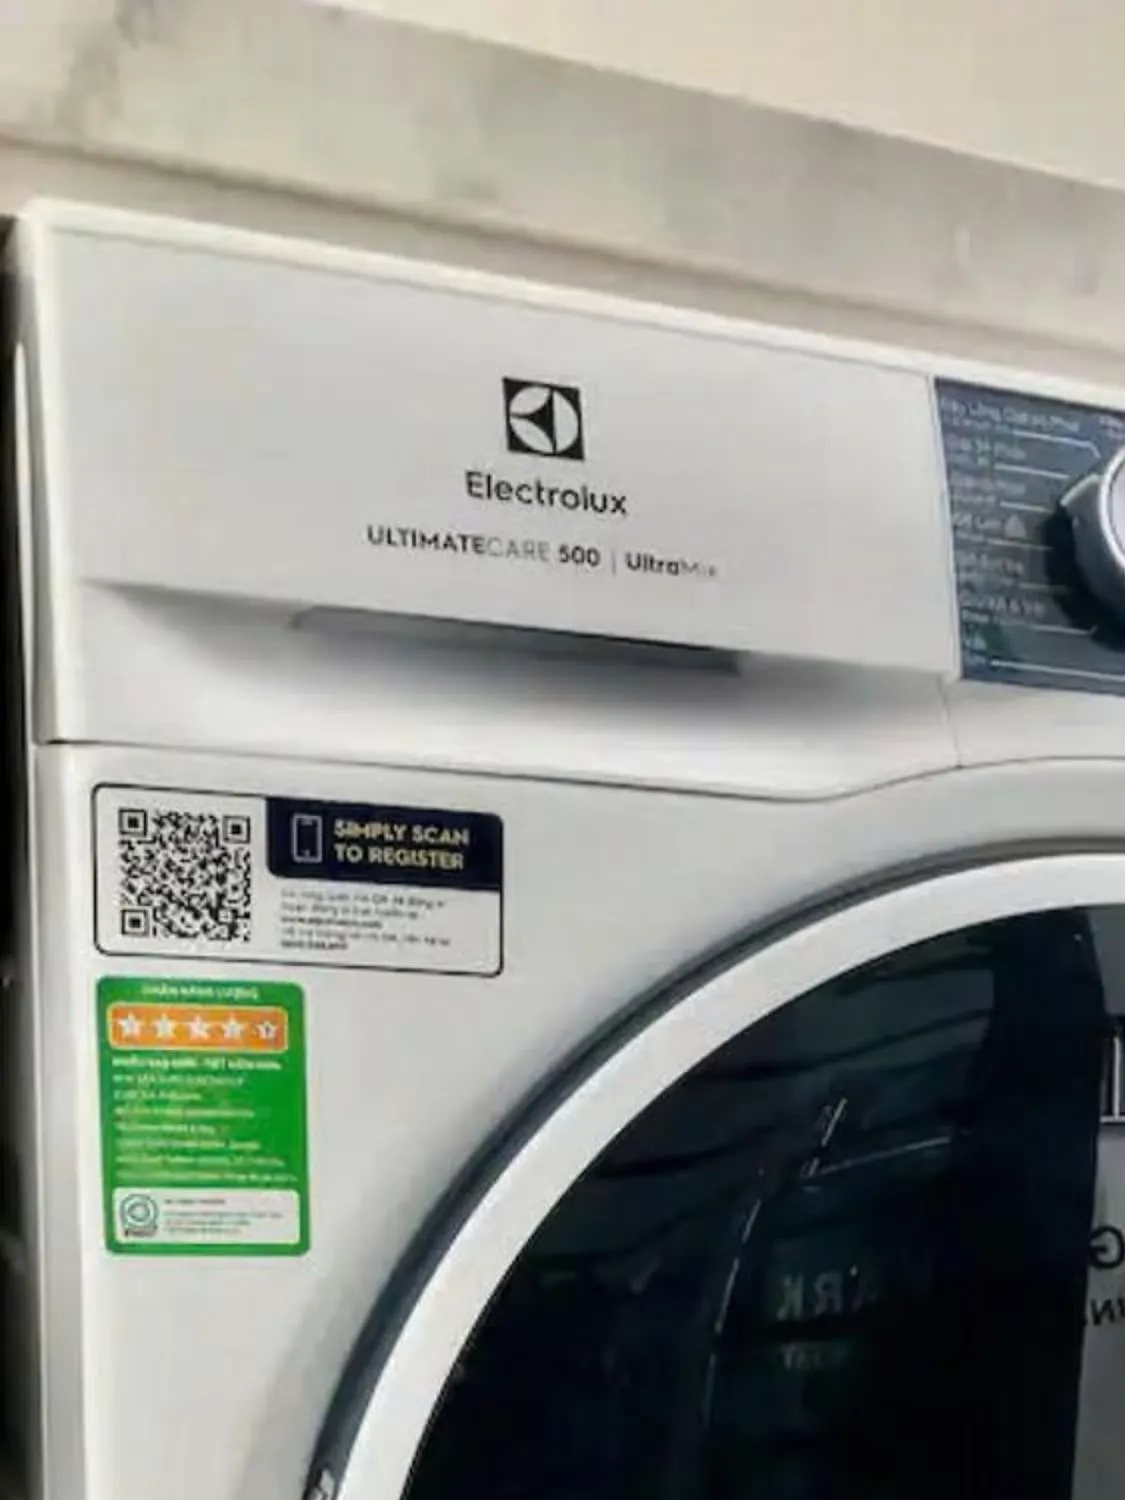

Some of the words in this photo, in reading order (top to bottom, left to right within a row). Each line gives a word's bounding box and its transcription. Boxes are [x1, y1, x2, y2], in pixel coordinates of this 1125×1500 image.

[465, 470, 628, 516] Electrolux
[366, 524, 551, 562] ULTIMATECARE
[558, 544, 601, 567] 500
[333, 818, 407, 841] SIMPLY
[411, 823, 470, 845] SCAN
[333, 842, 363, 864] TO
[367, 845, 465, 870] REGISTER
